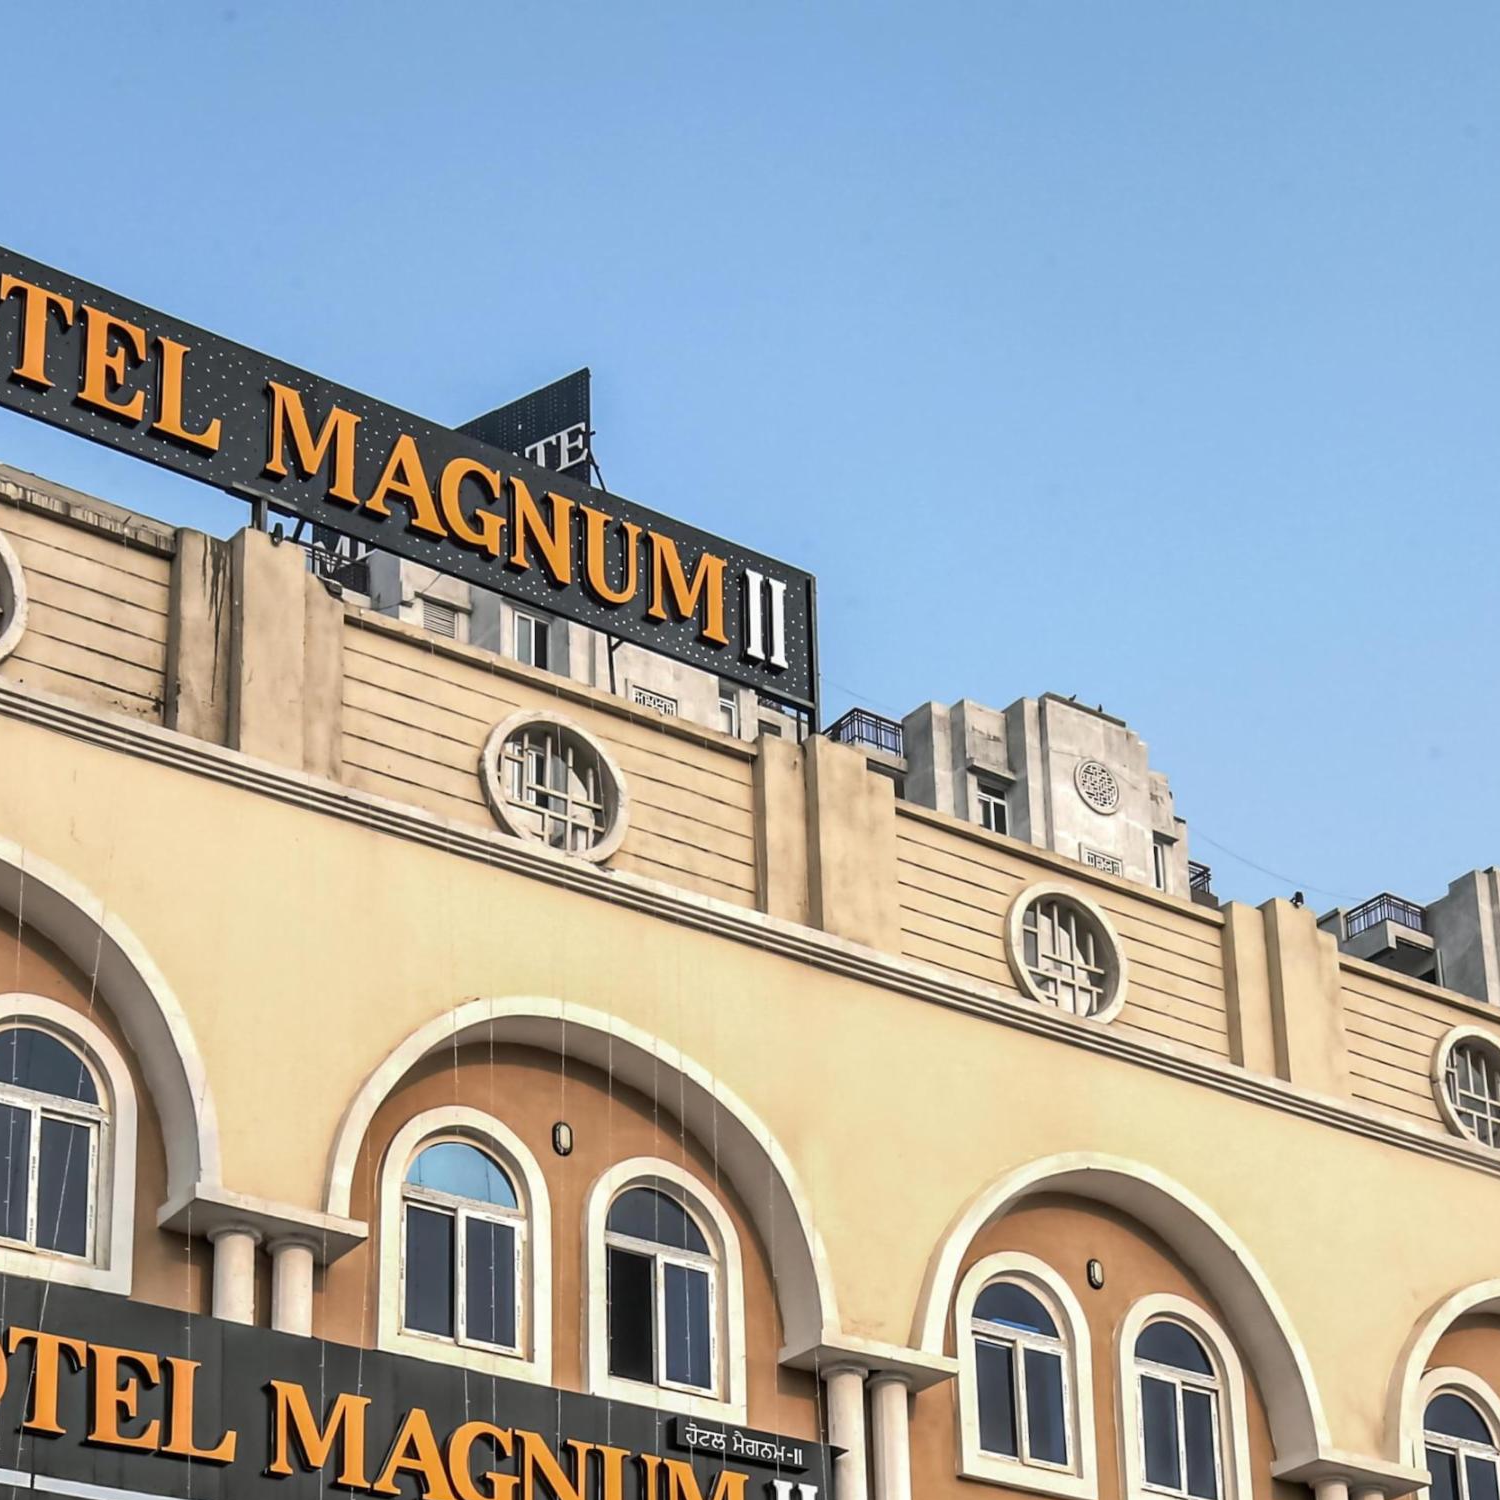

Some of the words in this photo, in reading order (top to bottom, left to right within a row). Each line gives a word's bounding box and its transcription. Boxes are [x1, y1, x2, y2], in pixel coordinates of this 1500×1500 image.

[265, 380, 729, 648] MAGNUM
[743, 568, 789, 670] II
[685, 1423, 727, 1451] ਹੋਟਲ
